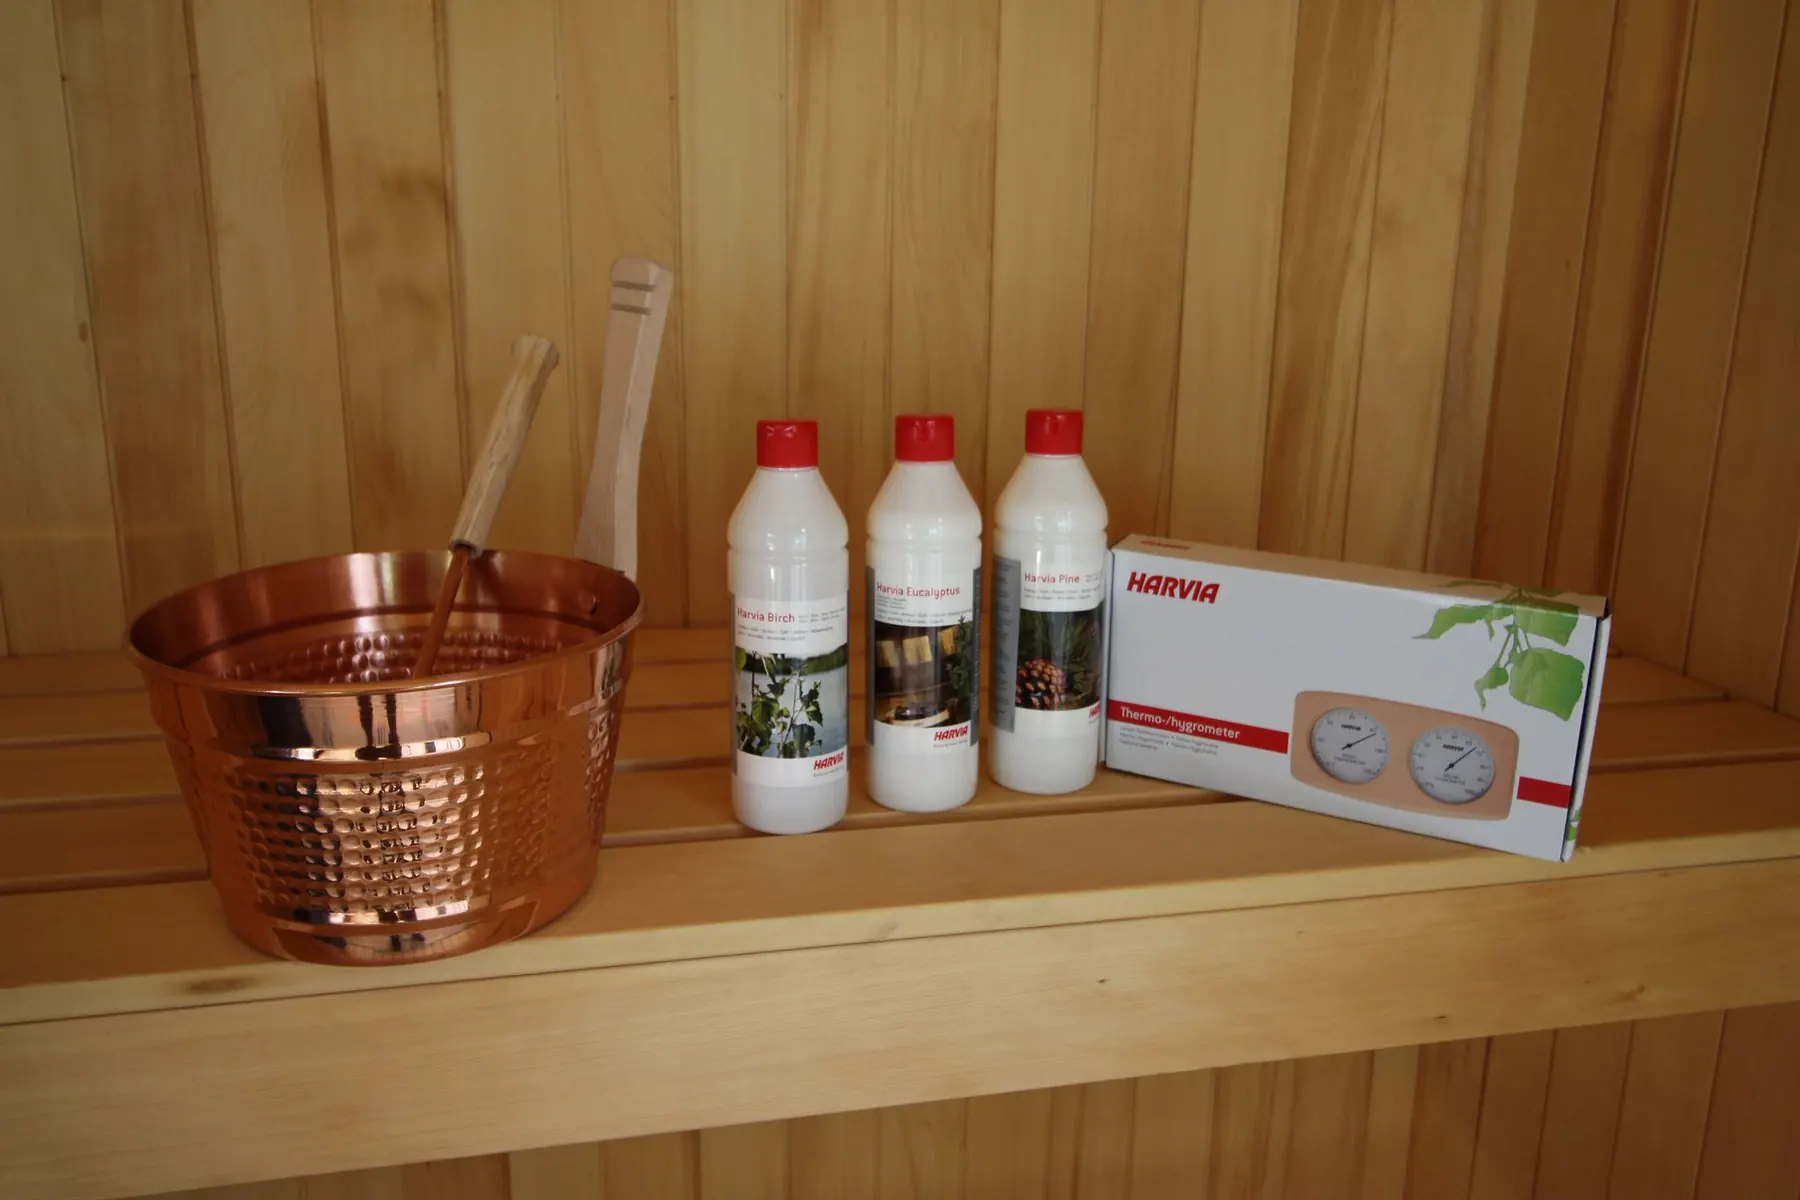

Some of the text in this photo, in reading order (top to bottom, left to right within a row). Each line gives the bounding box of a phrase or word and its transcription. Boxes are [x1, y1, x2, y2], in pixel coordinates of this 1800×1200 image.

[1024, 572, 1056, 584] Harvia
[1058, 574, 1080, 584] Pine
[876, 582, 961, 600] Harvia Eucalyptus
[1126, 571, 1221, 605] HARVIA
[737, 607, 765, 622] Harvia
[767, 612, 795, 624] Birch
[1120, 706, 1241, 739] Thermo-/hygrometer
[933, 725, 969, 741] HARVIA
[814, 752, 844, 770] HARVIA
